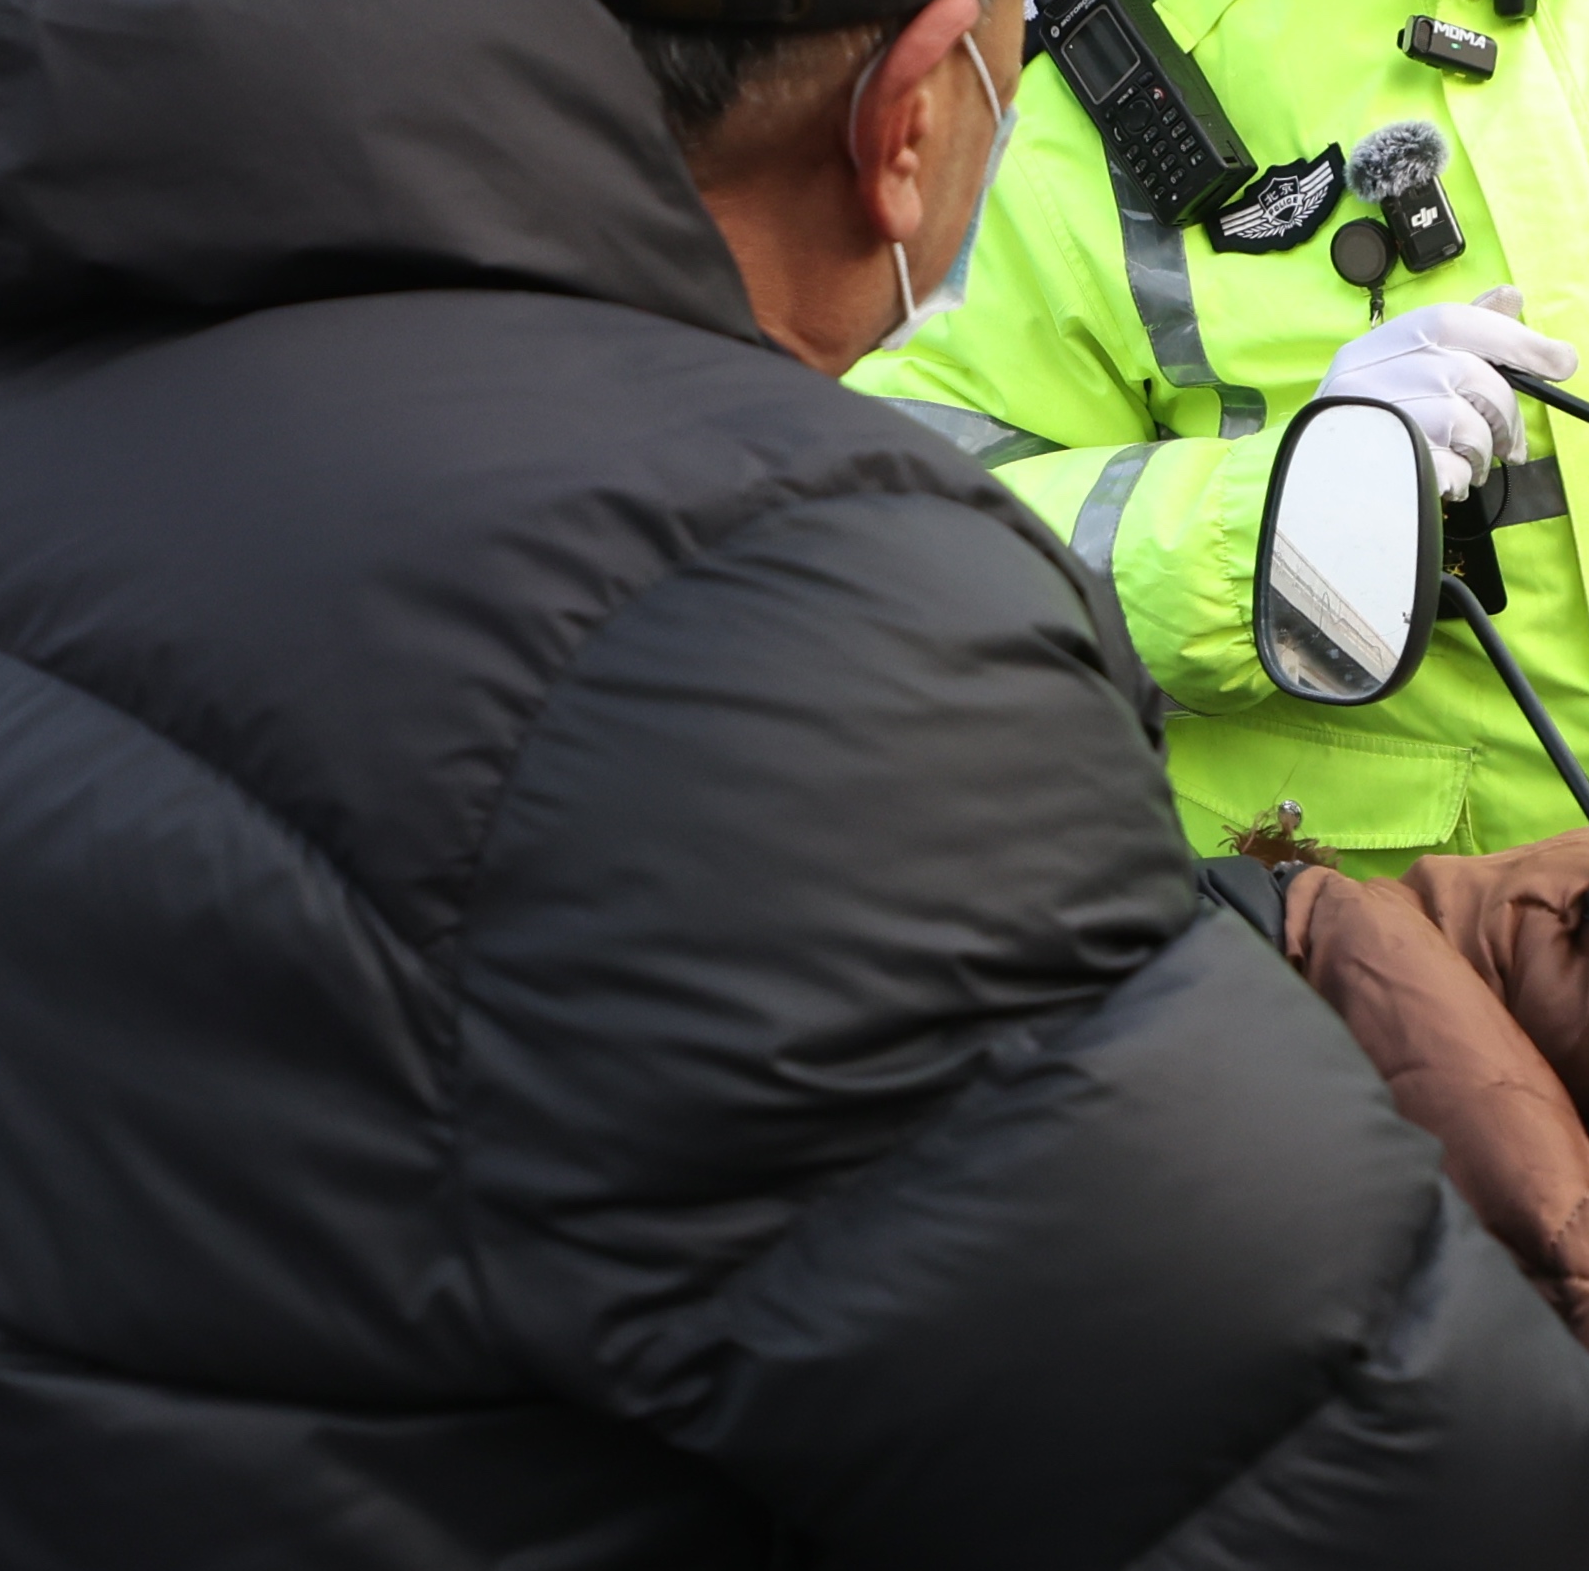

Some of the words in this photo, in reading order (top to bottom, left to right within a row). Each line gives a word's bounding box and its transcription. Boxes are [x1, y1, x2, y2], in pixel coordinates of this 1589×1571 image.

[1263, 182, 1295, 207] 北京
[1268, 195, 1299, 216] POLICE
[1411, 205, 1439, 228] dji
